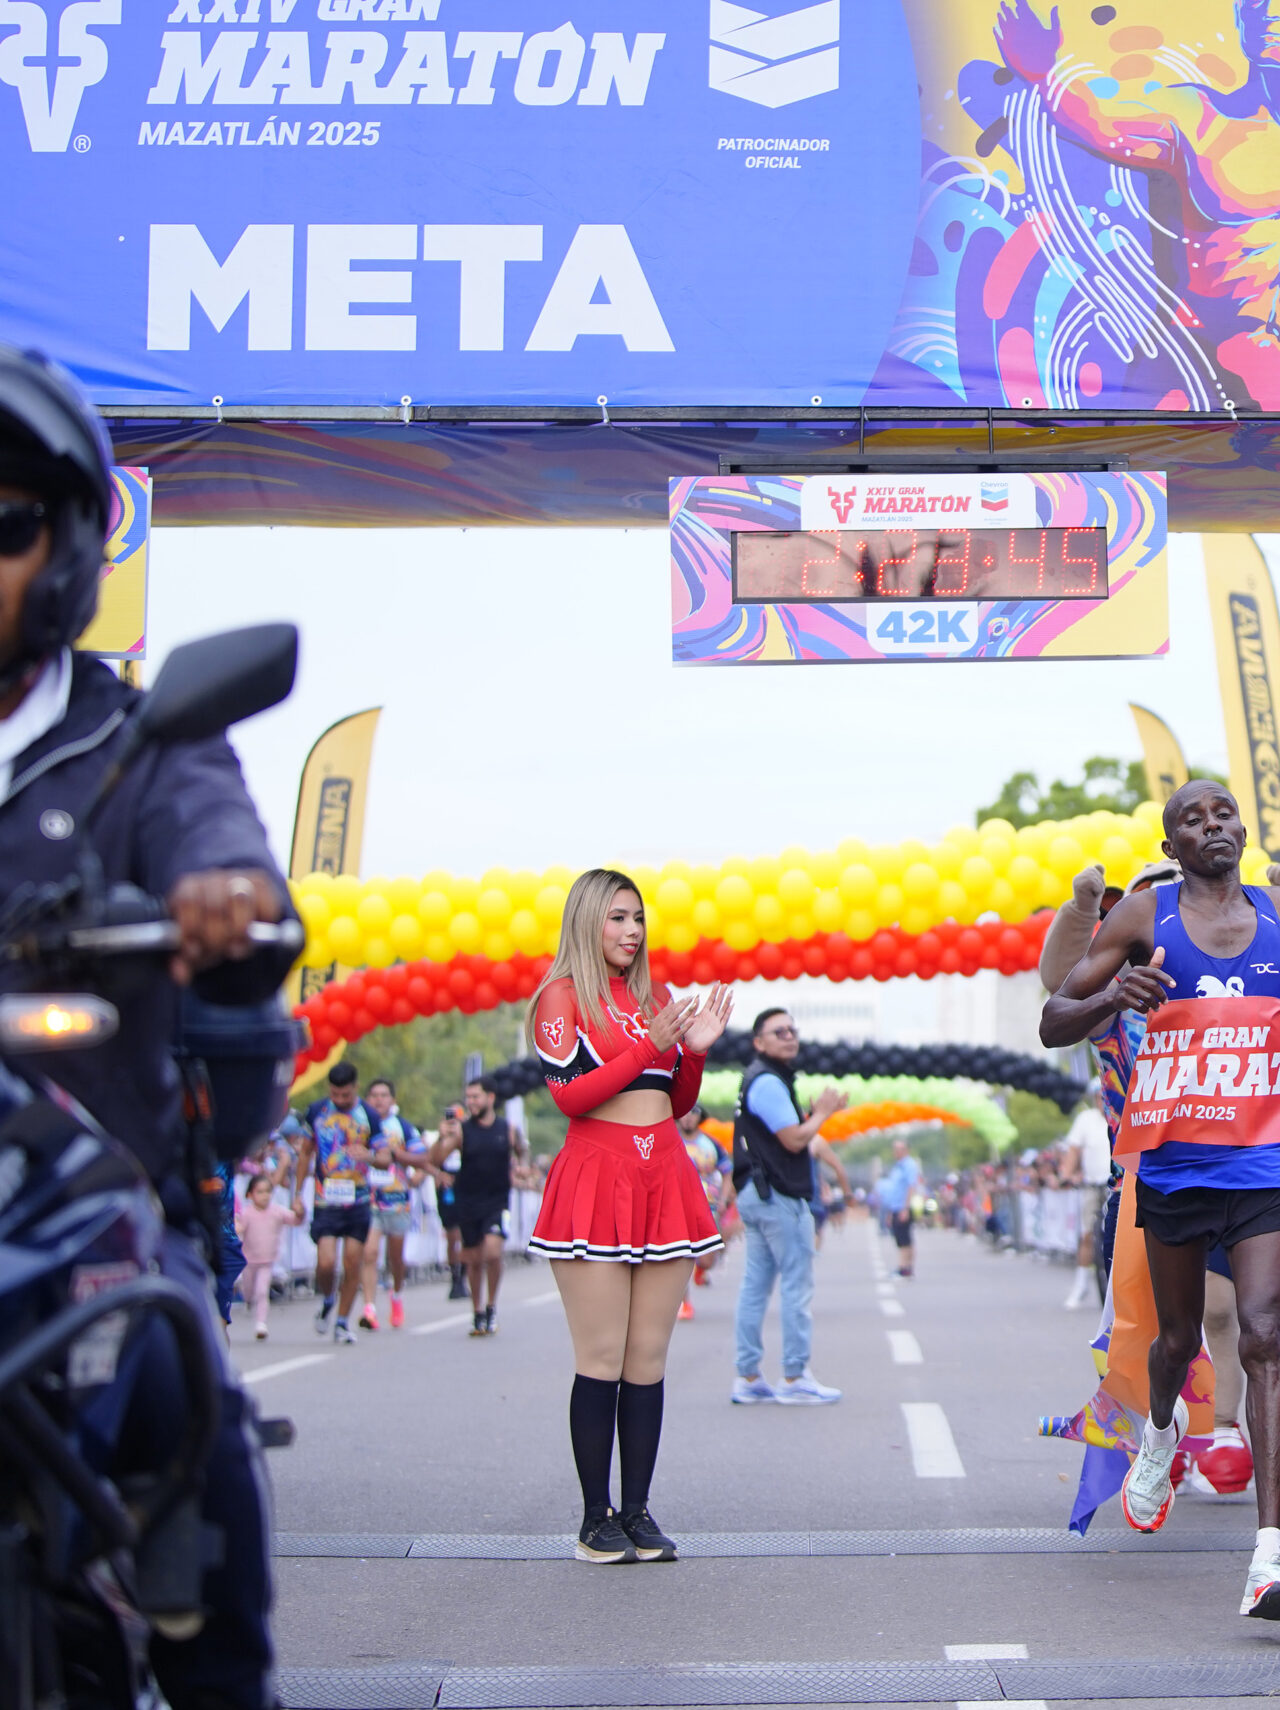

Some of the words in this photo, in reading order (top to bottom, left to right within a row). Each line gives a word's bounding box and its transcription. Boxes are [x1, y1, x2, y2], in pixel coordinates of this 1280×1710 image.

[317, 0, 441, 21] GRAN
[147, 21, 666, 106] MARATÓN
[138, 116, 300, 146] MAZATLÁN
[306, 121, 381, 146] 2025
[717, 137, 831, 153] PATROCINADOR
[745, 155, 802, 169] OFICIAL
[147, 224, 676, 352] META
[867, 487, 895, 496] XXIV
[898, 486, 925, 495] GRAN
[862, 495, 972, 514] MARATÓN
[876, 609, 971, 645] 42K
[1202, 1026, 1270, 1049] GRAN
[1130, 1103, 1193, 1128] MAZATLÁN
[1194, 1104, 1237, 1122] 2025
